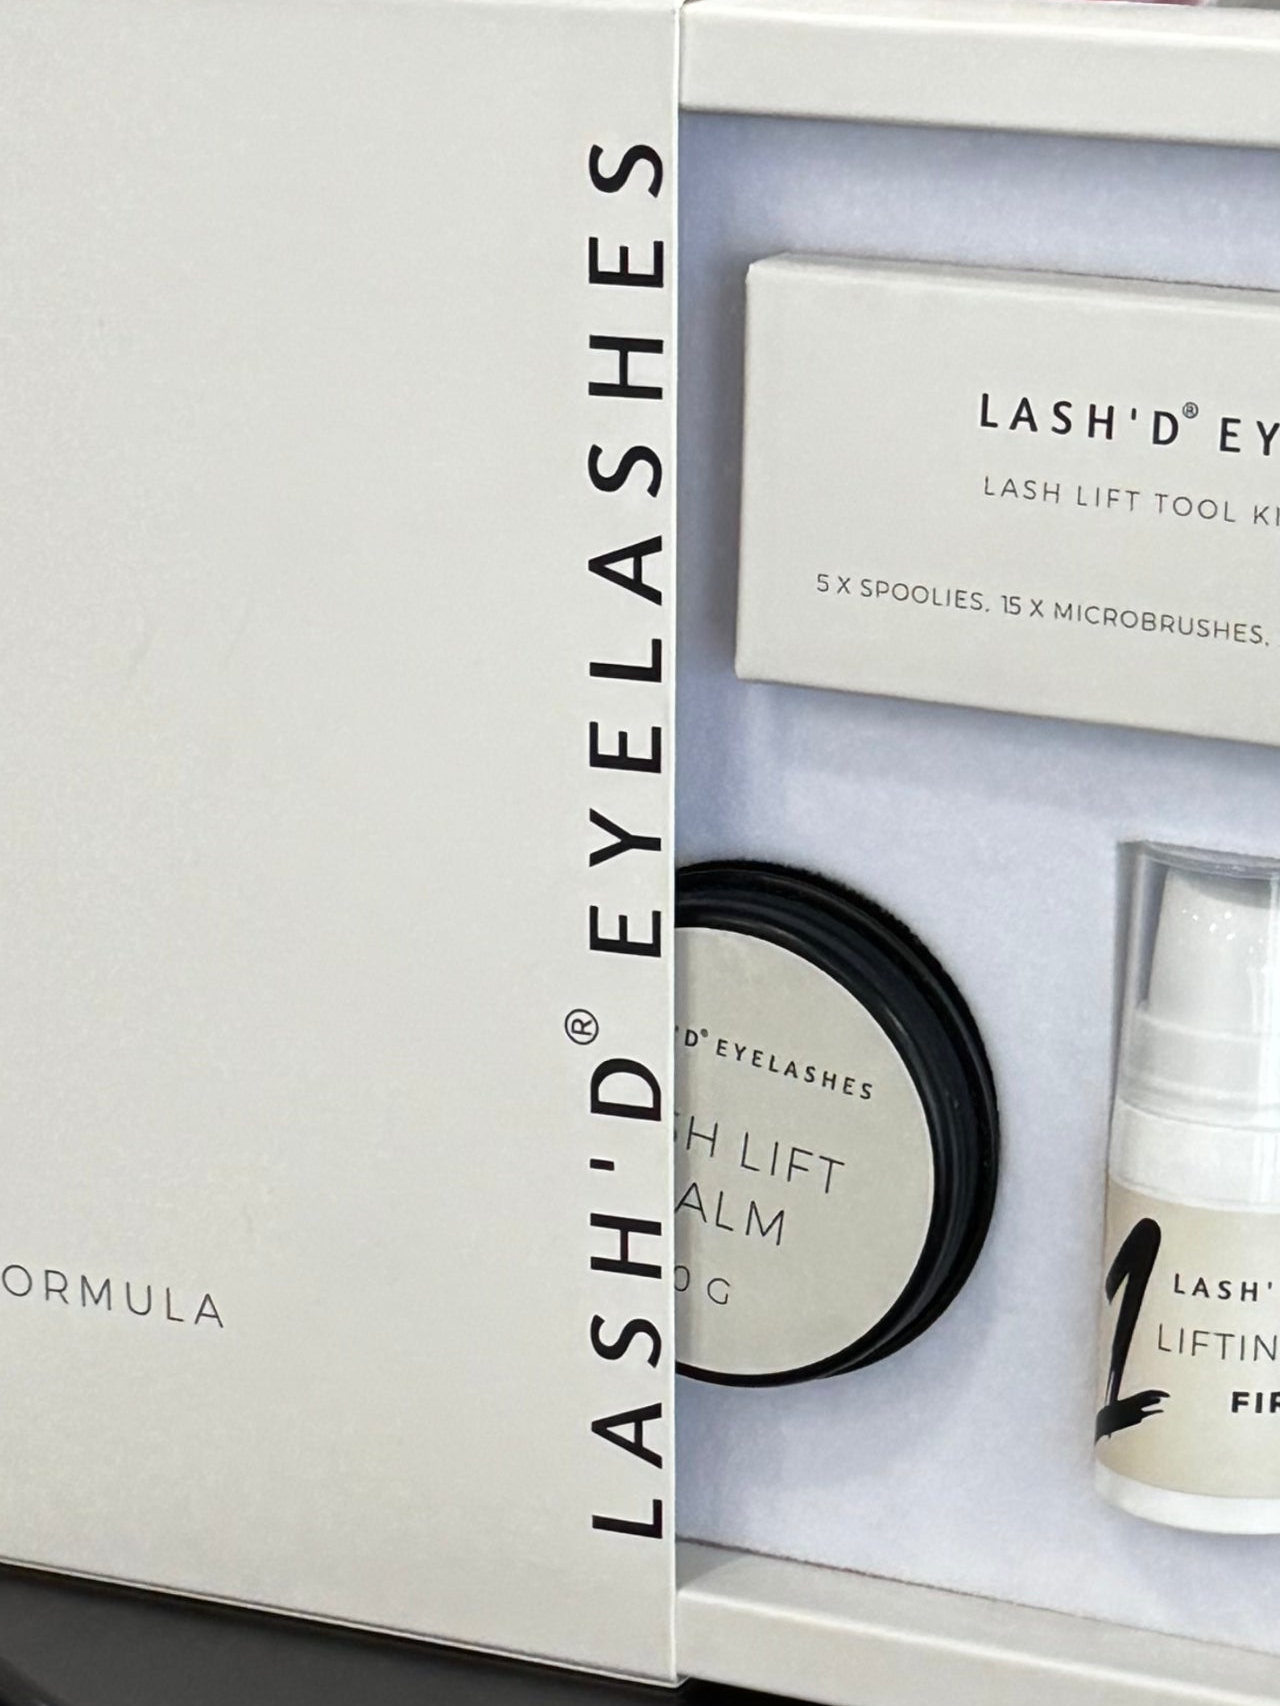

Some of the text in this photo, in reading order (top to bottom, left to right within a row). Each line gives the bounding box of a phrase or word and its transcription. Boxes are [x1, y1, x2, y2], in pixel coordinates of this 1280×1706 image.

[983, 475, 1062, 505] LASH
[1076, 485, 1141, 512] LIFT
[1154, 493, 1237, 524] TOOL
[588, 143, 665, 959] EYELASHES
[816, 573, 830, 593] 5
[836, 575, 851, 595] X
[1001, 594, 1022, 616] 15
[1029, 599, 1044, 619] X
[715, 1036, 874, 1101] EYELASHES
[739, 1131, 846, 1194] LIFT
[706, 1277, 731, 1305] G
[1095, 1217, 1170, 1445] 1
